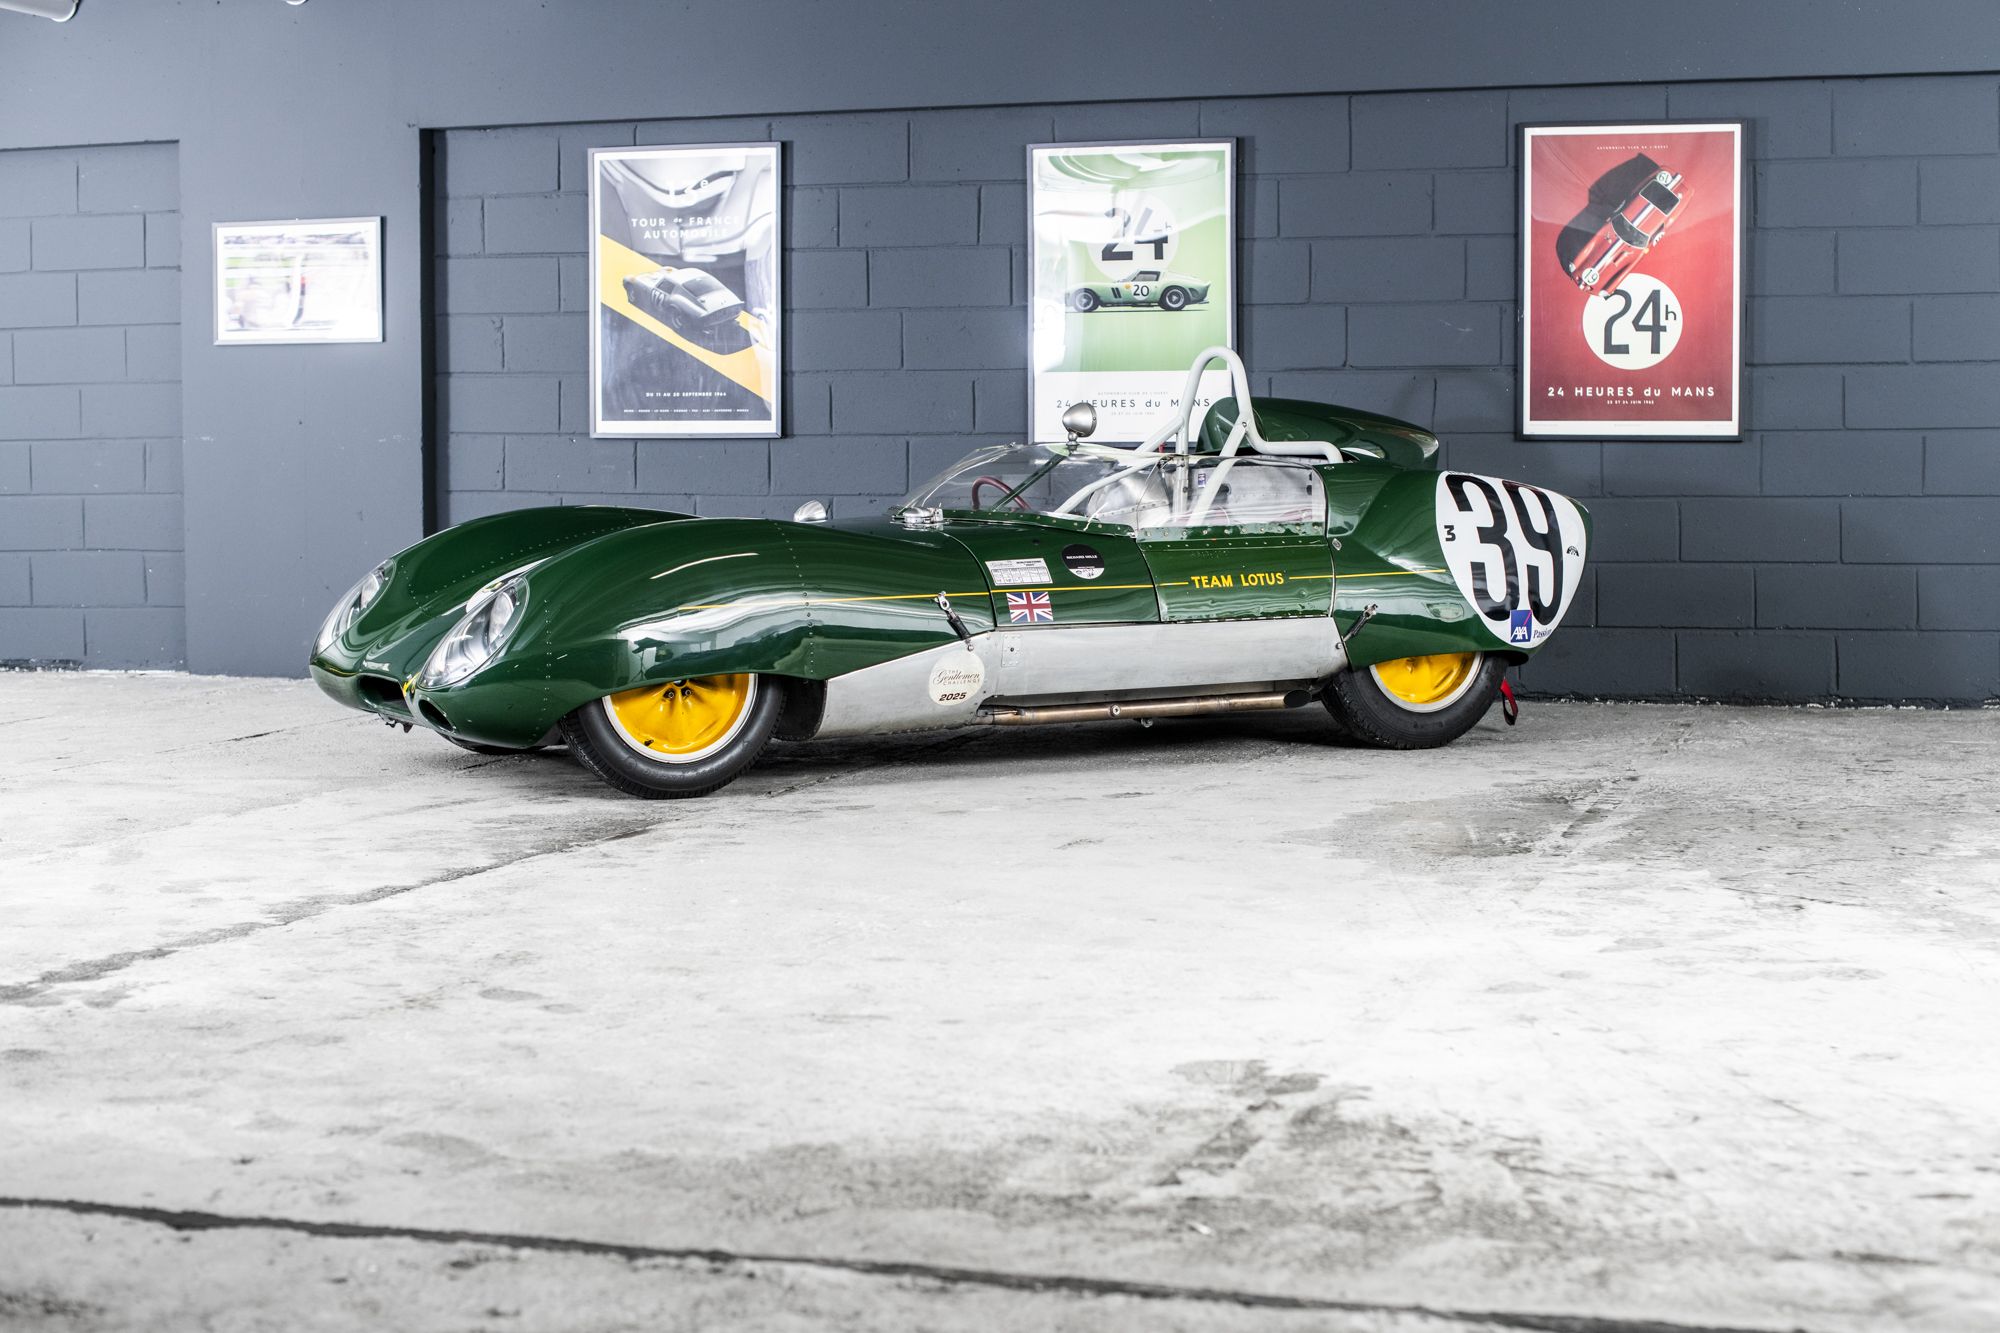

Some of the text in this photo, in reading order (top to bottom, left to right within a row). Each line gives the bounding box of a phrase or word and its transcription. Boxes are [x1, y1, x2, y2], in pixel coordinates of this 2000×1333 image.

[631, 217, 666, 228] TOUR
[689, 216, 740, 226] FRANCE
[643, 228, 729, 240] AUTOMOBILE
[1133, 284, 1150, 297] 20
[1547, 386, 1715, 397] 24 HEURES du MANS
[1145, 398, 1161, 408] du
[1170, 398, 1210, 408] MNS
[1443, 525, 1456, 542] 3
[1445, 474, 1564, 626] 39
[1190, 572, 1285, 589] TEAM LOTUS
[1510, 626, 1529, 640] AXA
[933, 670, 980, 685] Gentlemen
[939, 691, 968, 702] 2025
